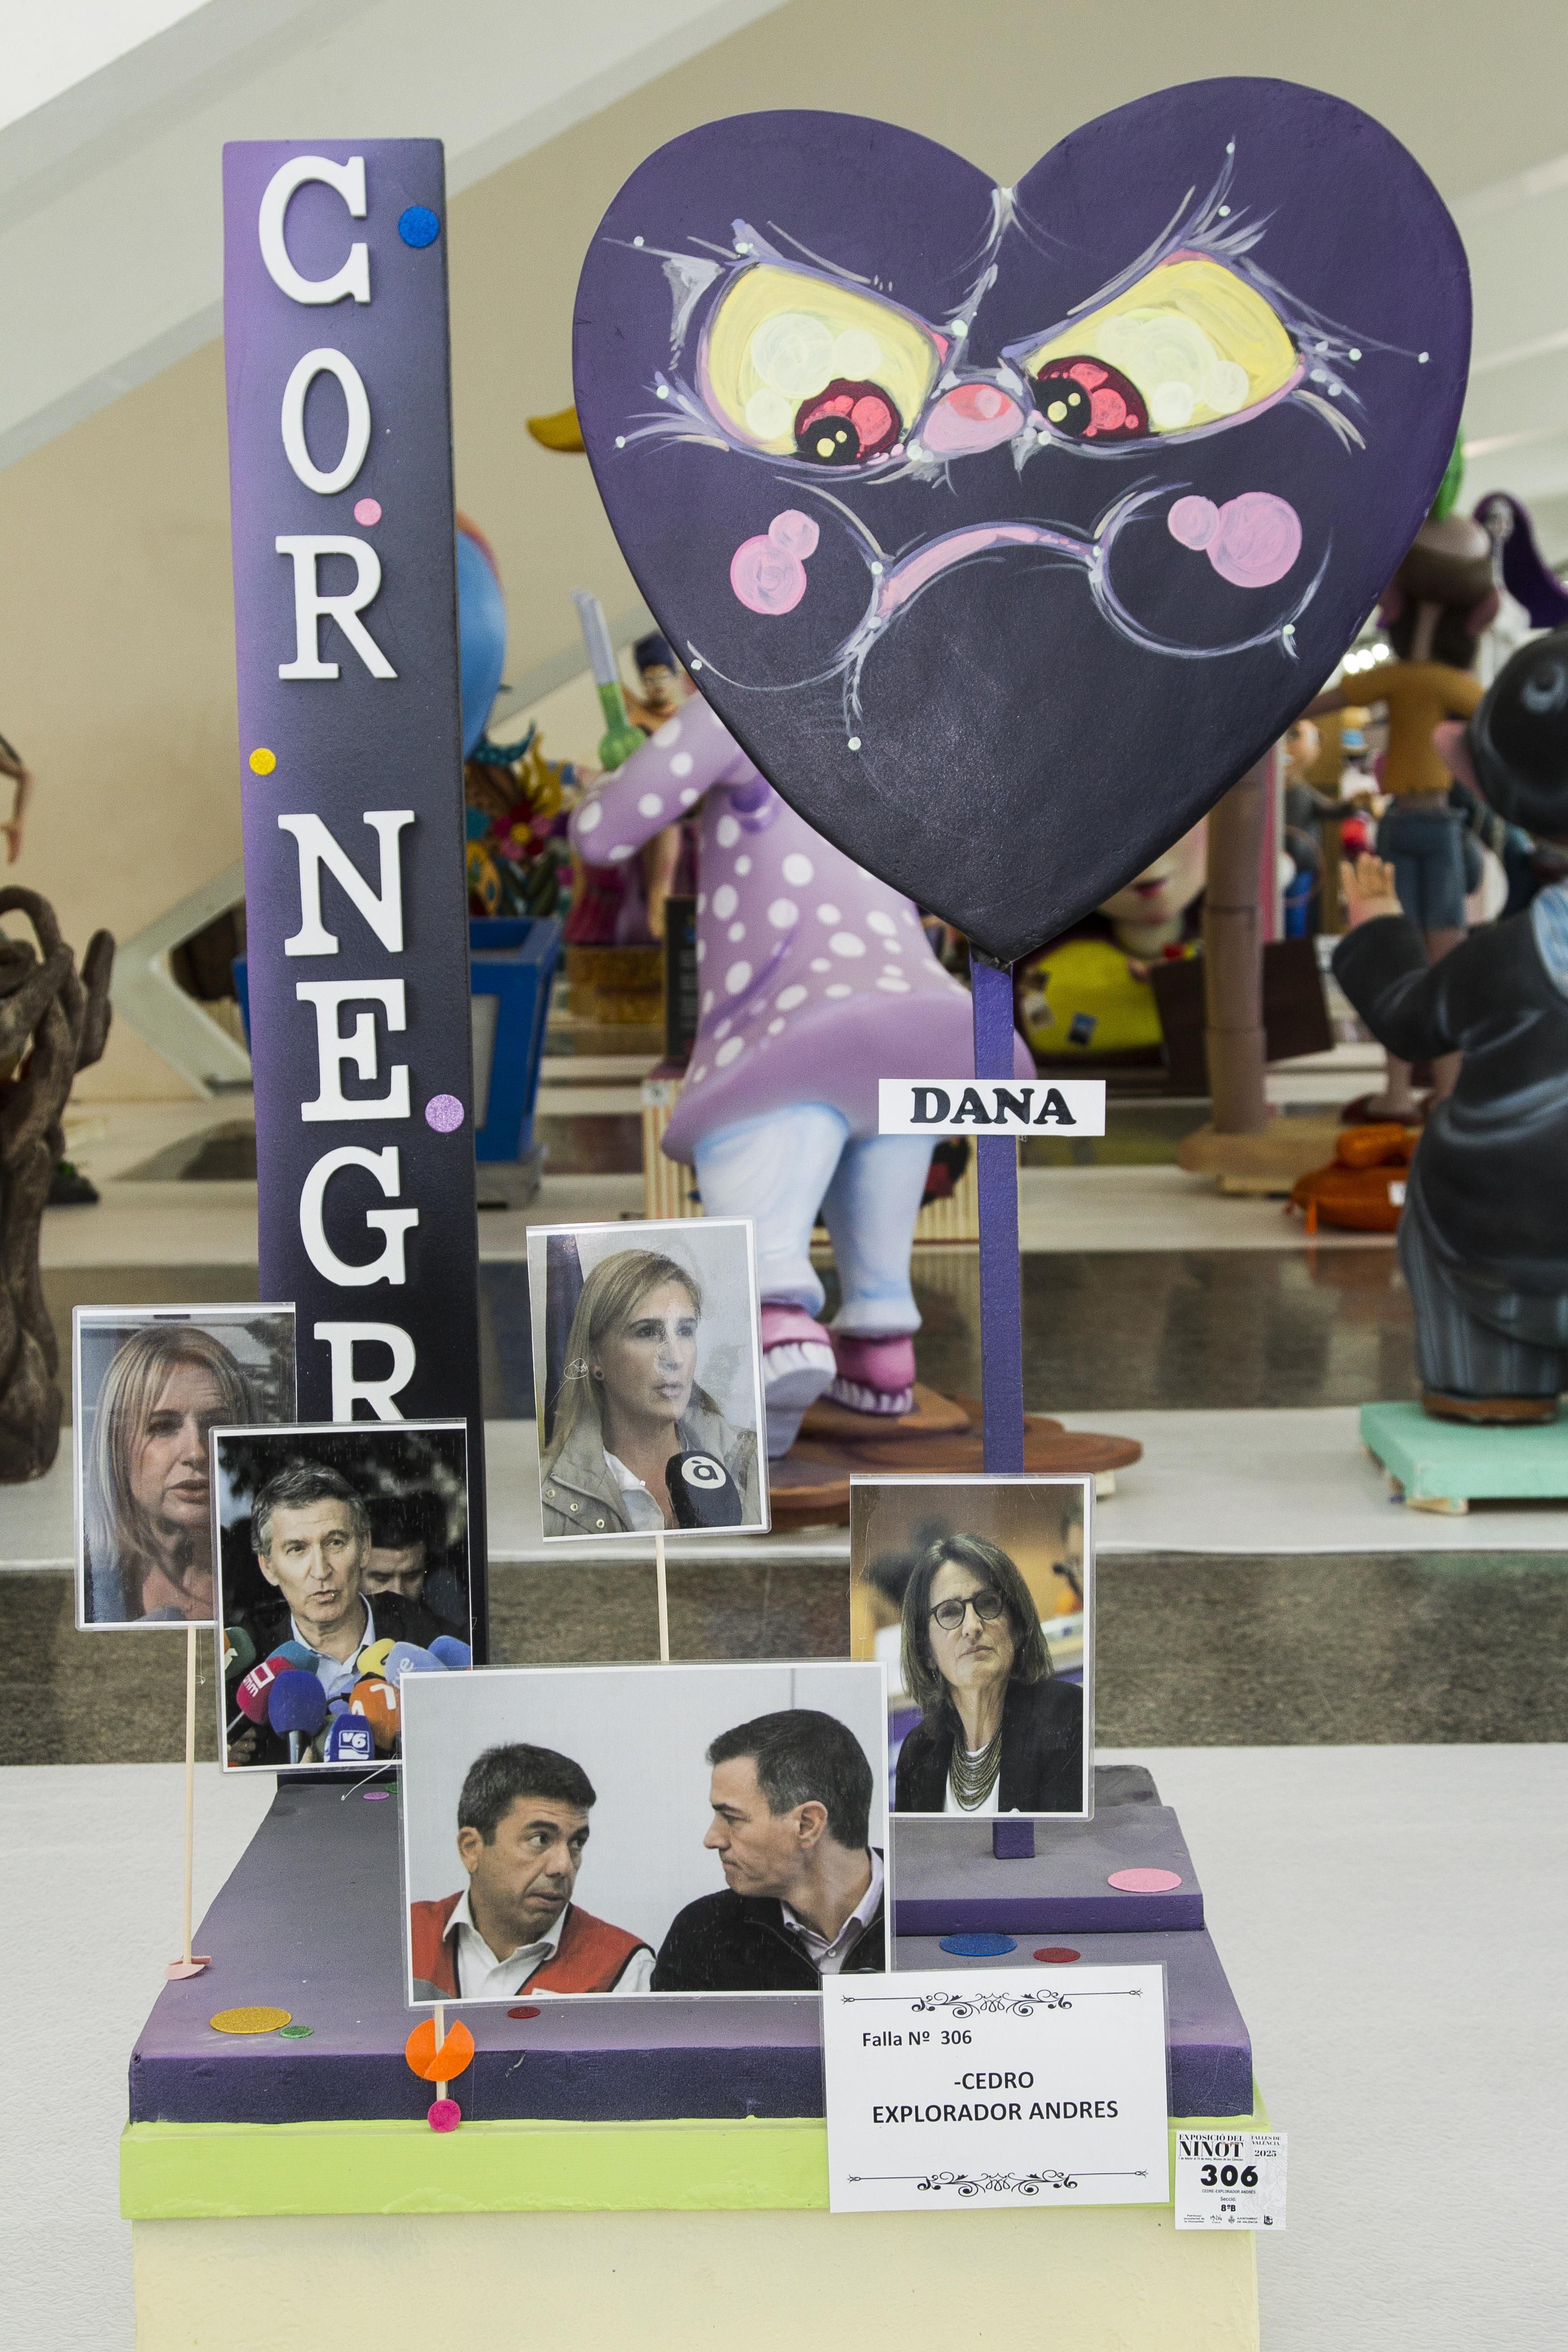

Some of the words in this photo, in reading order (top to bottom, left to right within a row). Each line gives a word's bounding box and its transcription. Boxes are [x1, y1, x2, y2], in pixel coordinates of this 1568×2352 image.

[258, 155, 398, 679] COR
[910, 1087, 1077, 1125] DANA
[862, 2031, 903, 2047] Falla
[908, 2031, 930, 2046] Nº
[941, 2030, 972, 2045] 306
[954, 2071, 1034, 2090] -CEDRO
[872, 2102, 1021, 2124] EXPLORADOR
[1029, 2100, 1118, 2120] ANDRES
[1179, 2141, 1244, 2157] NINOT
[1200, 2164, 1259, 2187] 306
